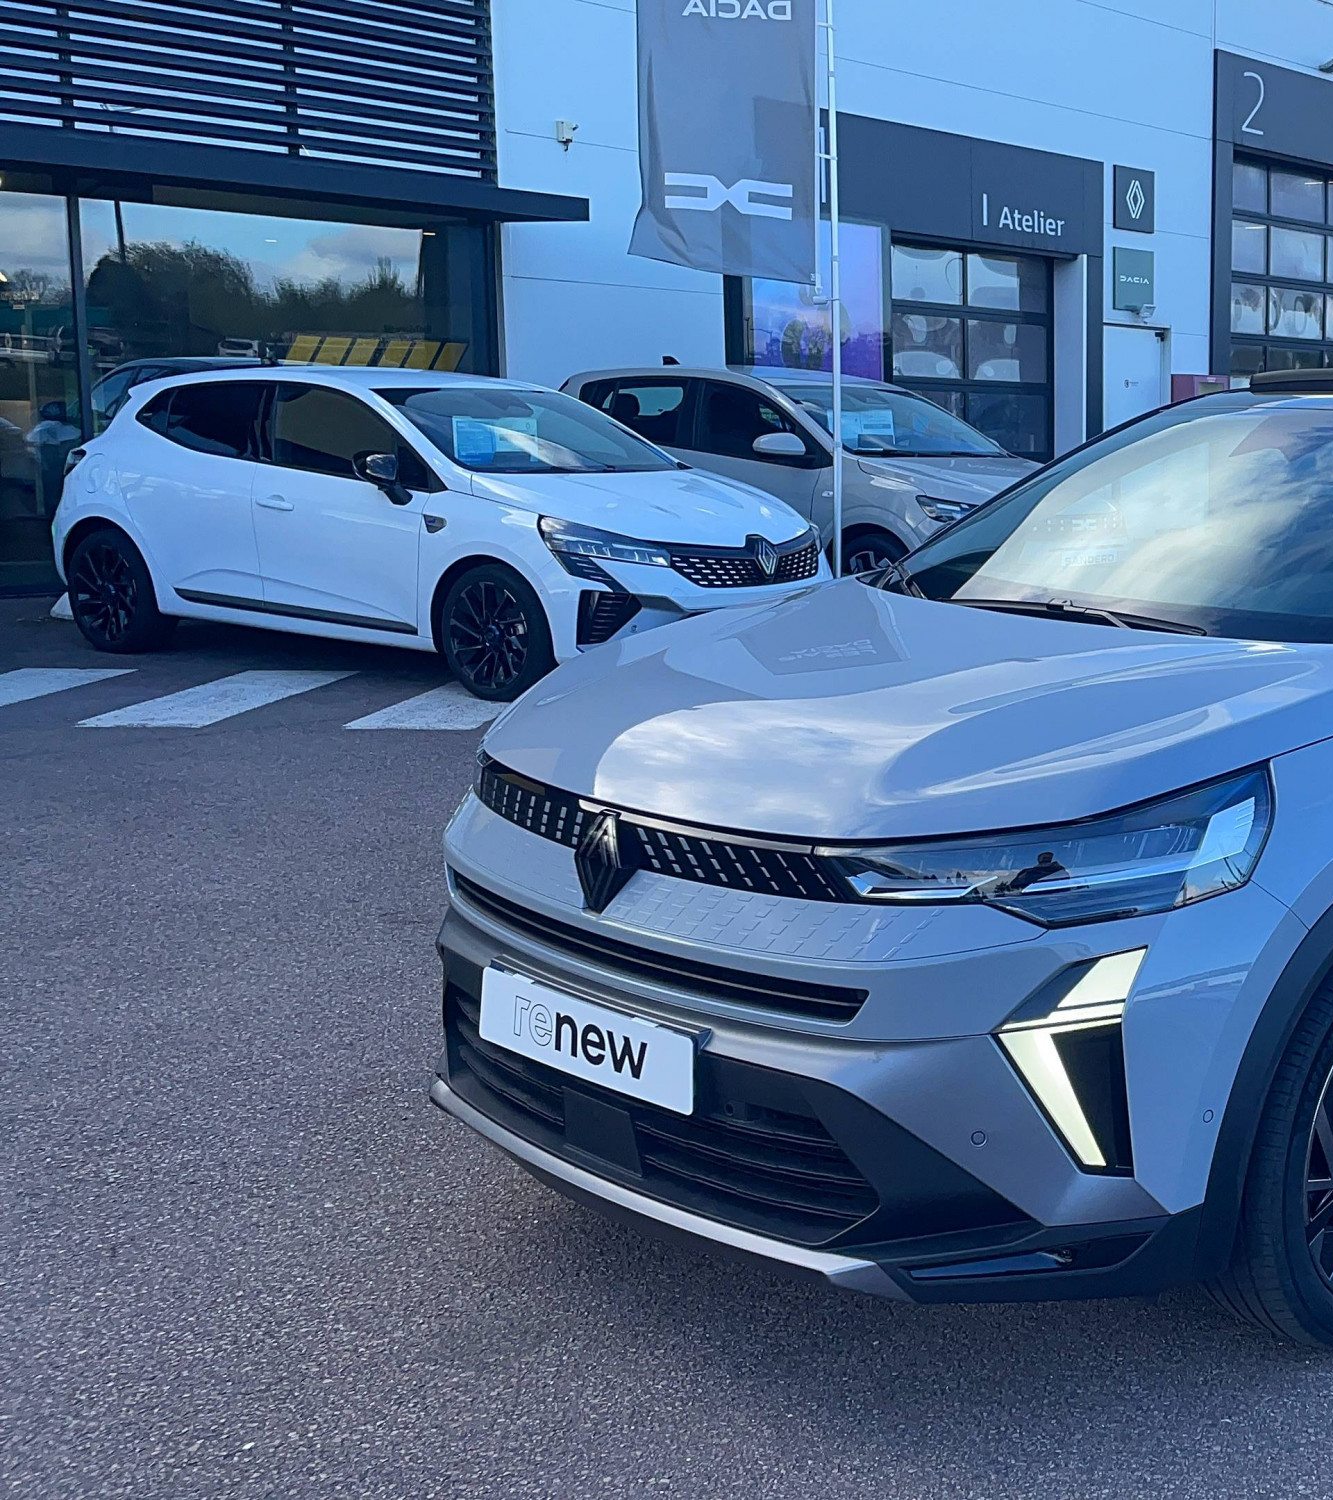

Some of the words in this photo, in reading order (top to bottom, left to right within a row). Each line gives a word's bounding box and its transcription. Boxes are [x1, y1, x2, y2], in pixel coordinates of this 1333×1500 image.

[1241, 71, 1265, 136] 2
[999, 206, 1065, 236] Atelier
[1120, 275, 1150, 285] DACIA
[513, 995, 648, 1080] renew
